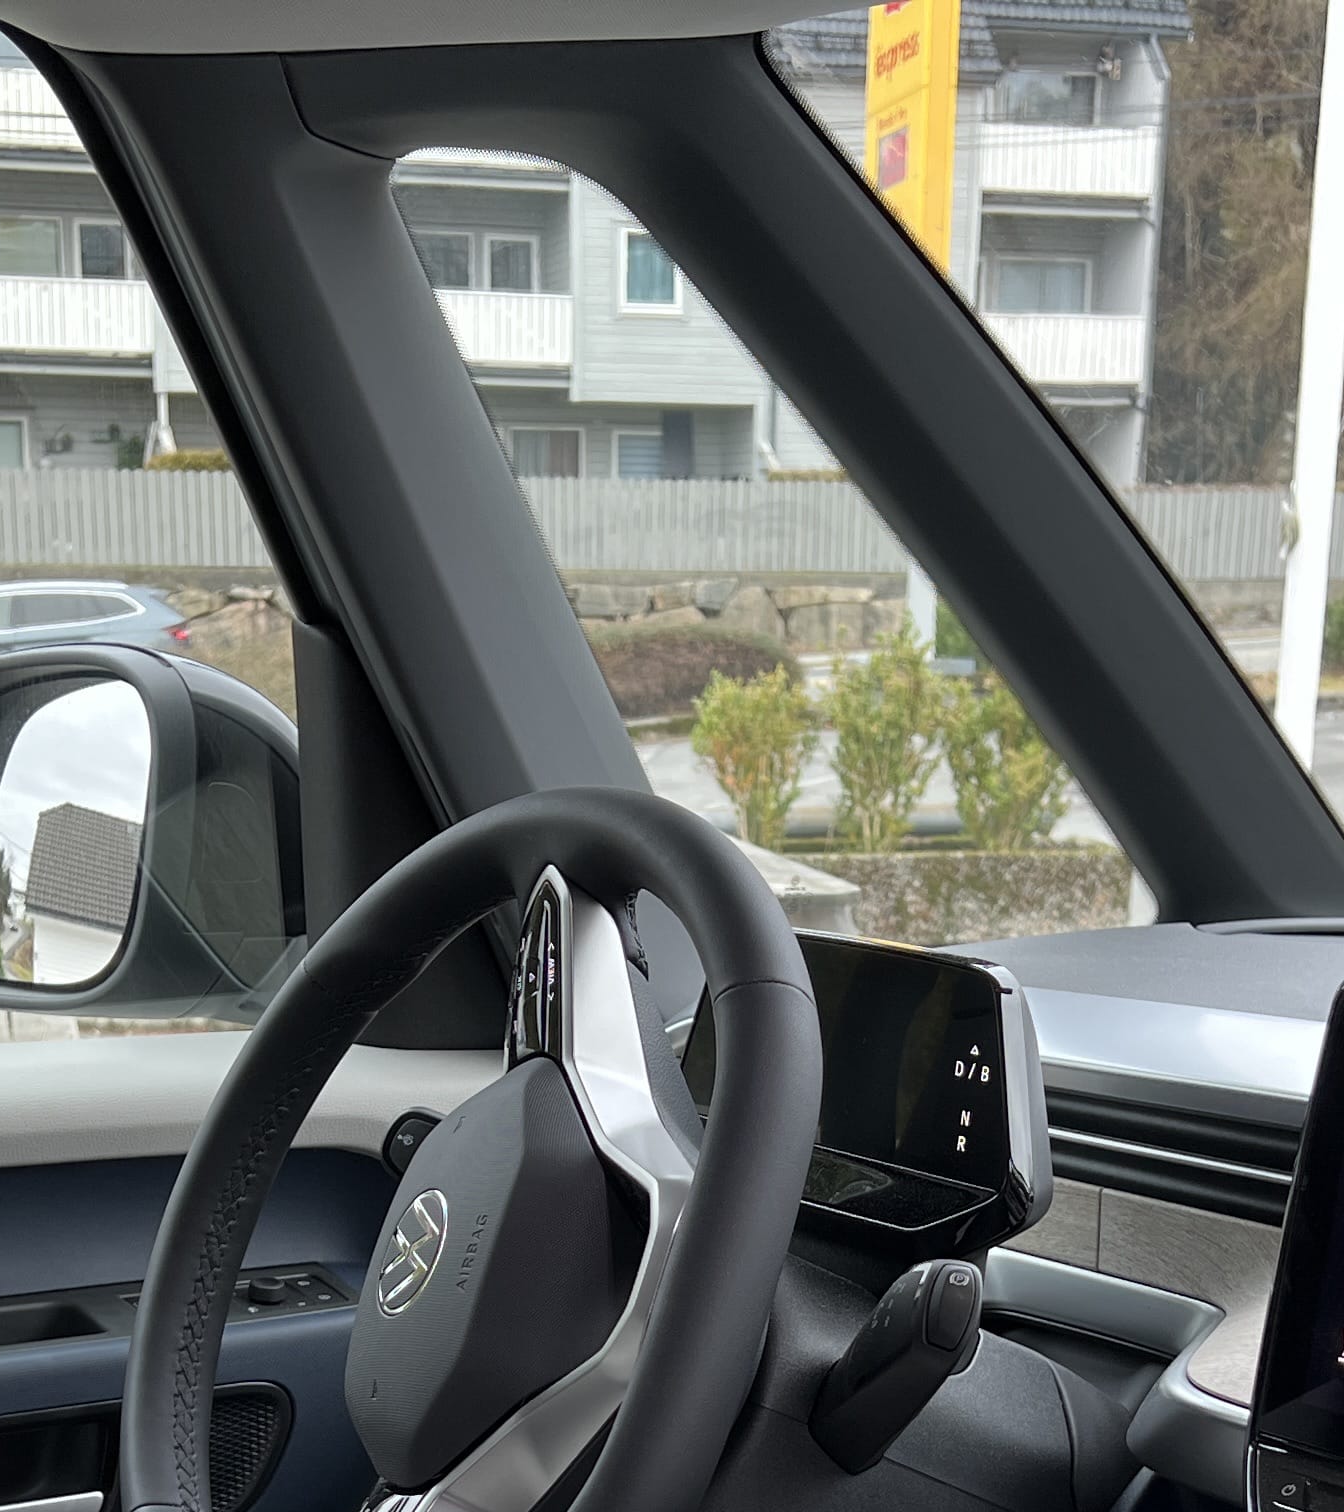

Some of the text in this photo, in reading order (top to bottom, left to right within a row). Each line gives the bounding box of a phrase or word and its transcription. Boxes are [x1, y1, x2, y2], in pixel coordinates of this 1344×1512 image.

[959, 1109, 971, 1127] N
[956, 1135, 966, 1152] R
[456, 1213, 489, 1292] AIRBAG
